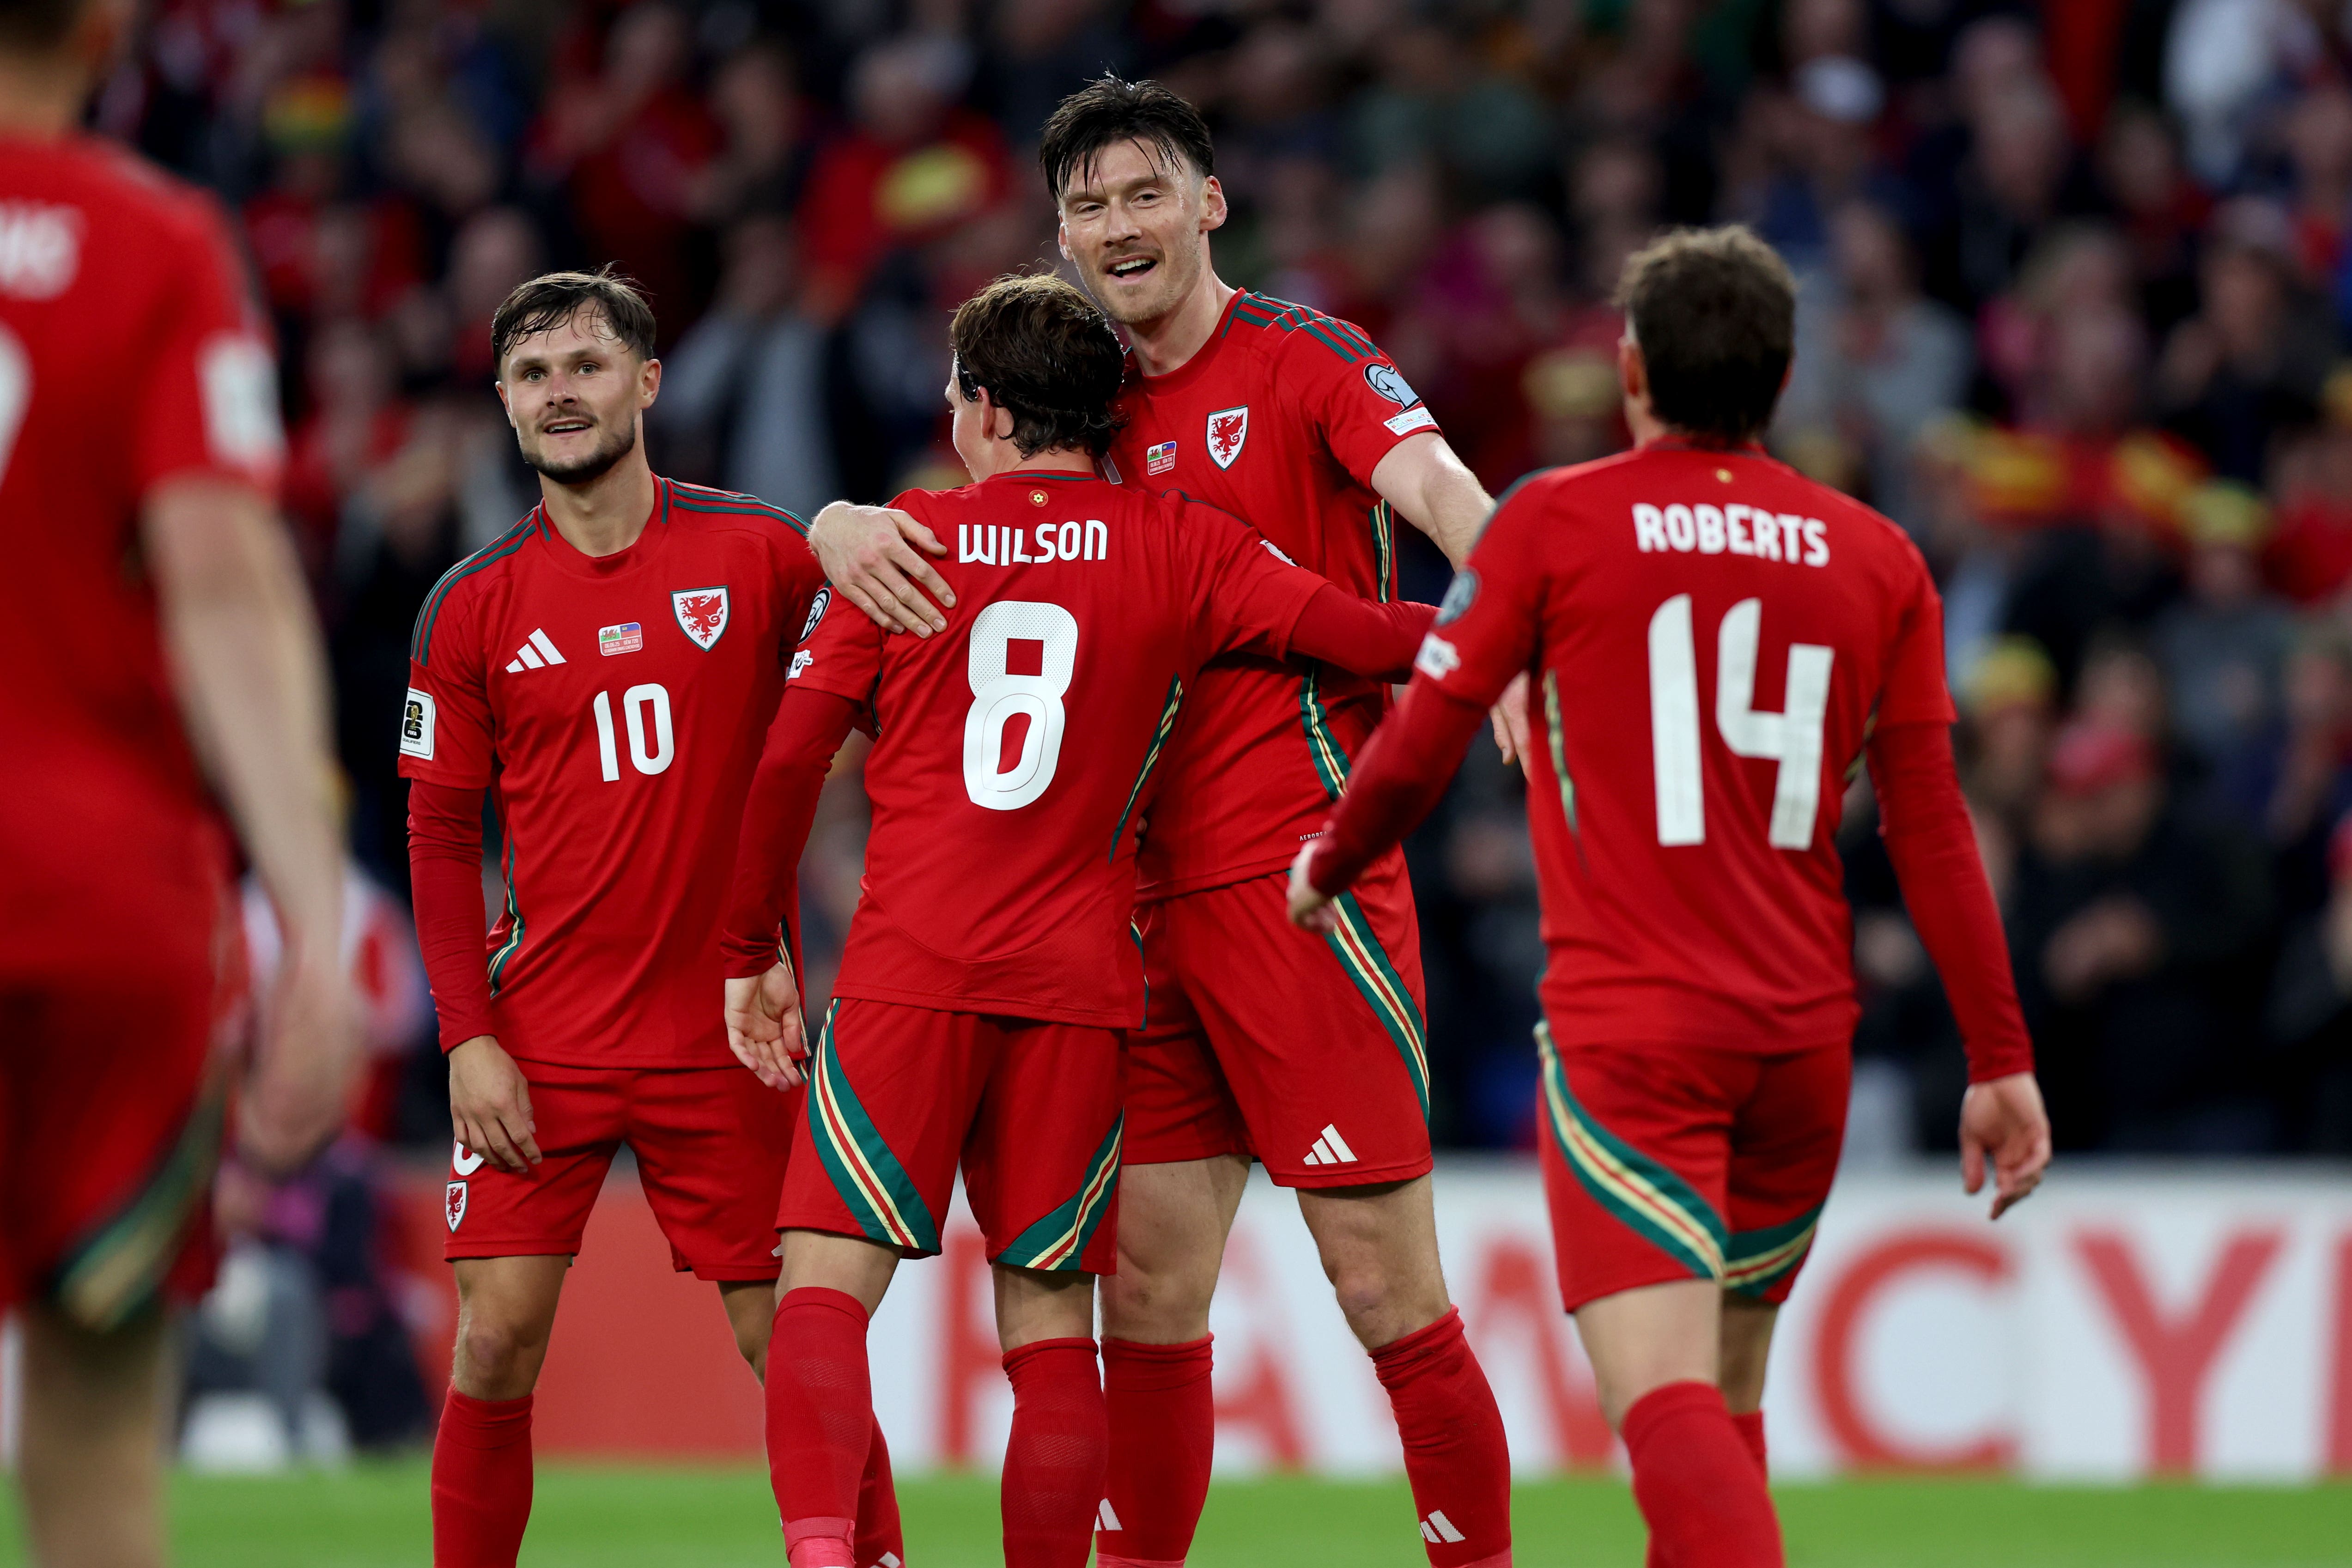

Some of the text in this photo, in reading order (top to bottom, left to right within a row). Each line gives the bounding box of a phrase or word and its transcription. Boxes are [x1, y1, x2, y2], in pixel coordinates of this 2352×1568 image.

[959, 520, 1108, 566] WILSON
[1631, 502, 1830, 568] ROBERTS
[593, 683, 675, 782] 10
[963, 600, 1078, 811] 8
[1647, 593, 1835, 851] 14
